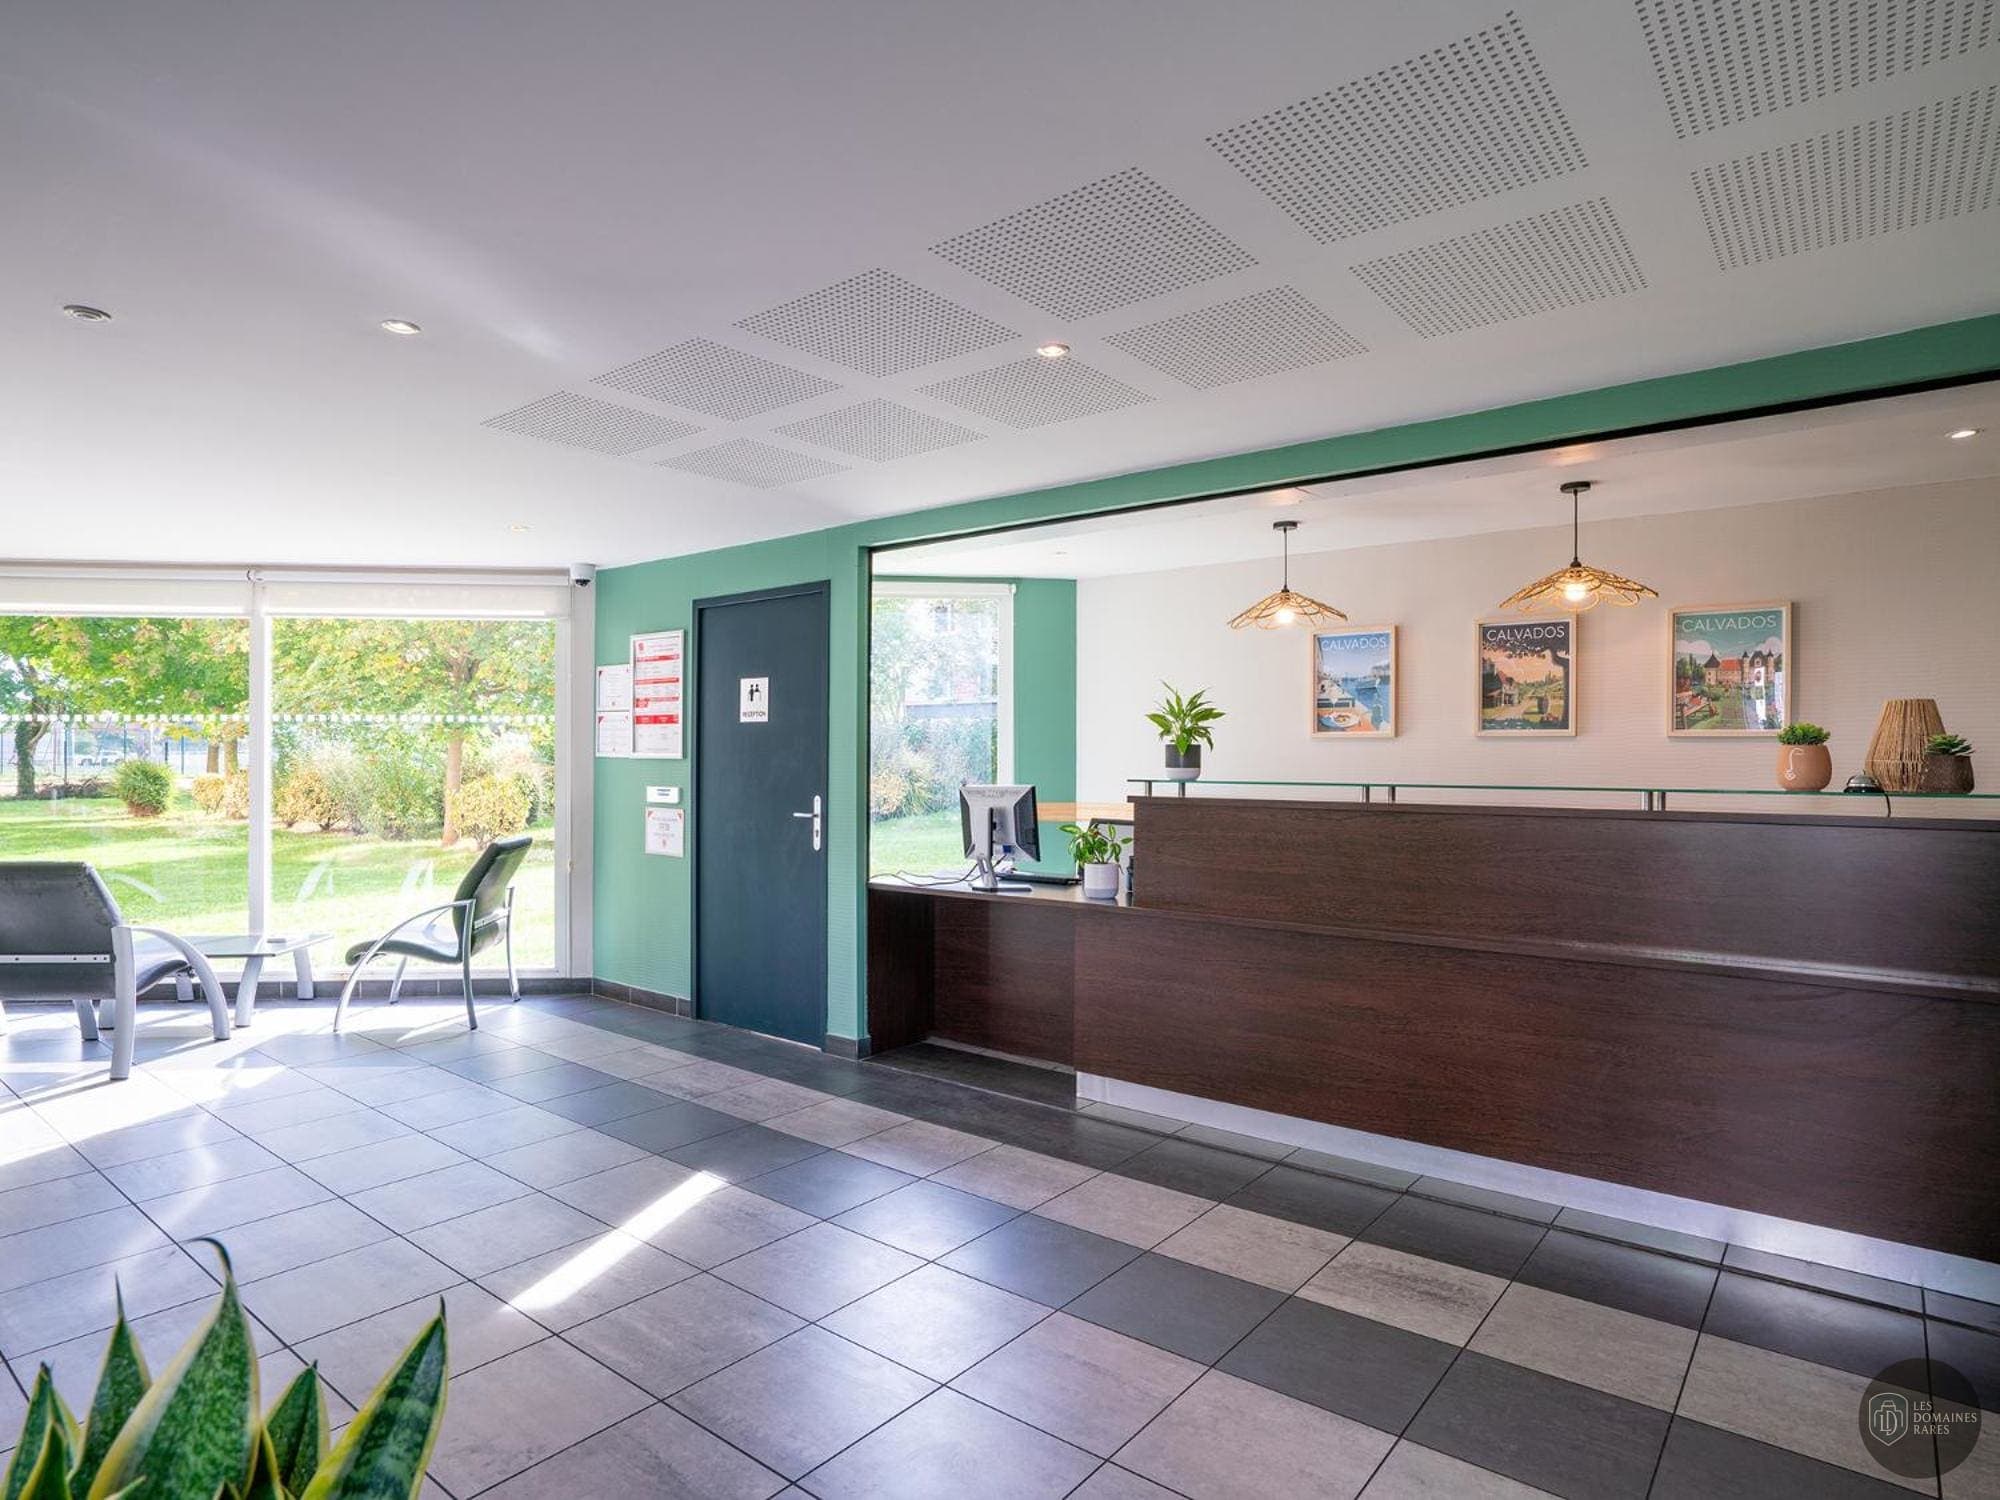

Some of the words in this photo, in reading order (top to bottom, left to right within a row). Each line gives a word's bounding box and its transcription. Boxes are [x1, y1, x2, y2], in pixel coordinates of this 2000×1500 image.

[1682, 614, 1777, 632] CALVADOS
[1486, 625, 1565, 641] CALVADOS
[1321, 637, 1387, 651] CALVADOS
